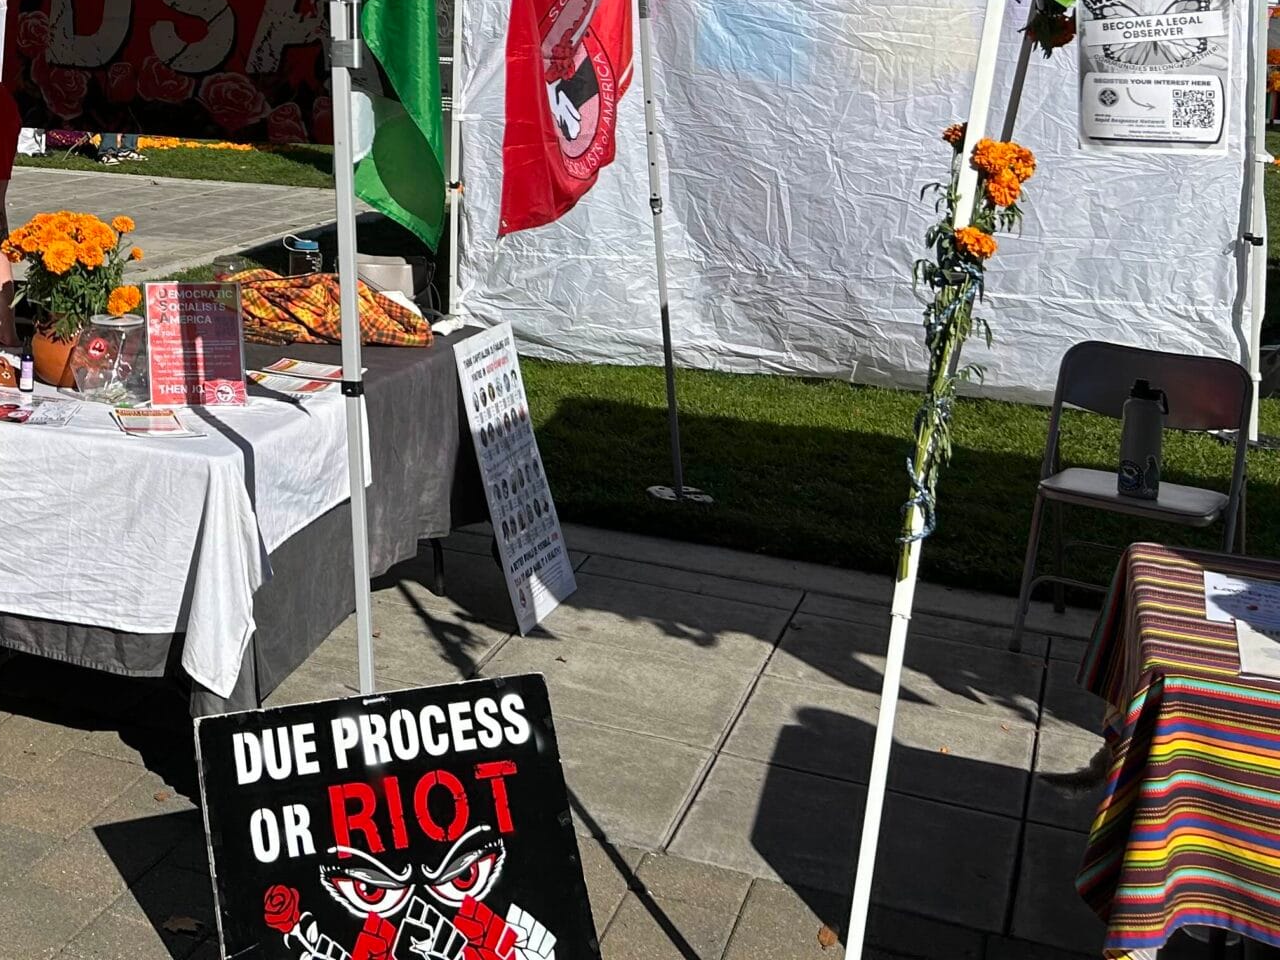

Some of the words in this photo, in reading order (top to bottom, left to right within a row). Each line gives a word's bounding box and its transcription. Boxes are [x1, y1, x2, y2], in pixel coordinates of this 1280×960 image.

[1102, 19, 1152, 31] BECOME
[1155, 18, 1164, 26] A
[1166, 15, 1203, 26] LEGAL
[1123, 28, 1183, 39] OBSERVER
[1149, 62, 1181, 72] BELONG
[593, 52, 614, 126] AMERICA
[158, 288, 233, 299] DEMOCRATIC
[159, 300, 226, 312] SOCIALISTS
[160, 313, 212, 324] AMERICA
[158, 384, 188, 394] THEN
[232, 722, 320, 785] DUE
[330, 694, 531, 769] PROCESS
[249, 803, 316, 864] OR
[328, 760, 518, 859] RIOT
